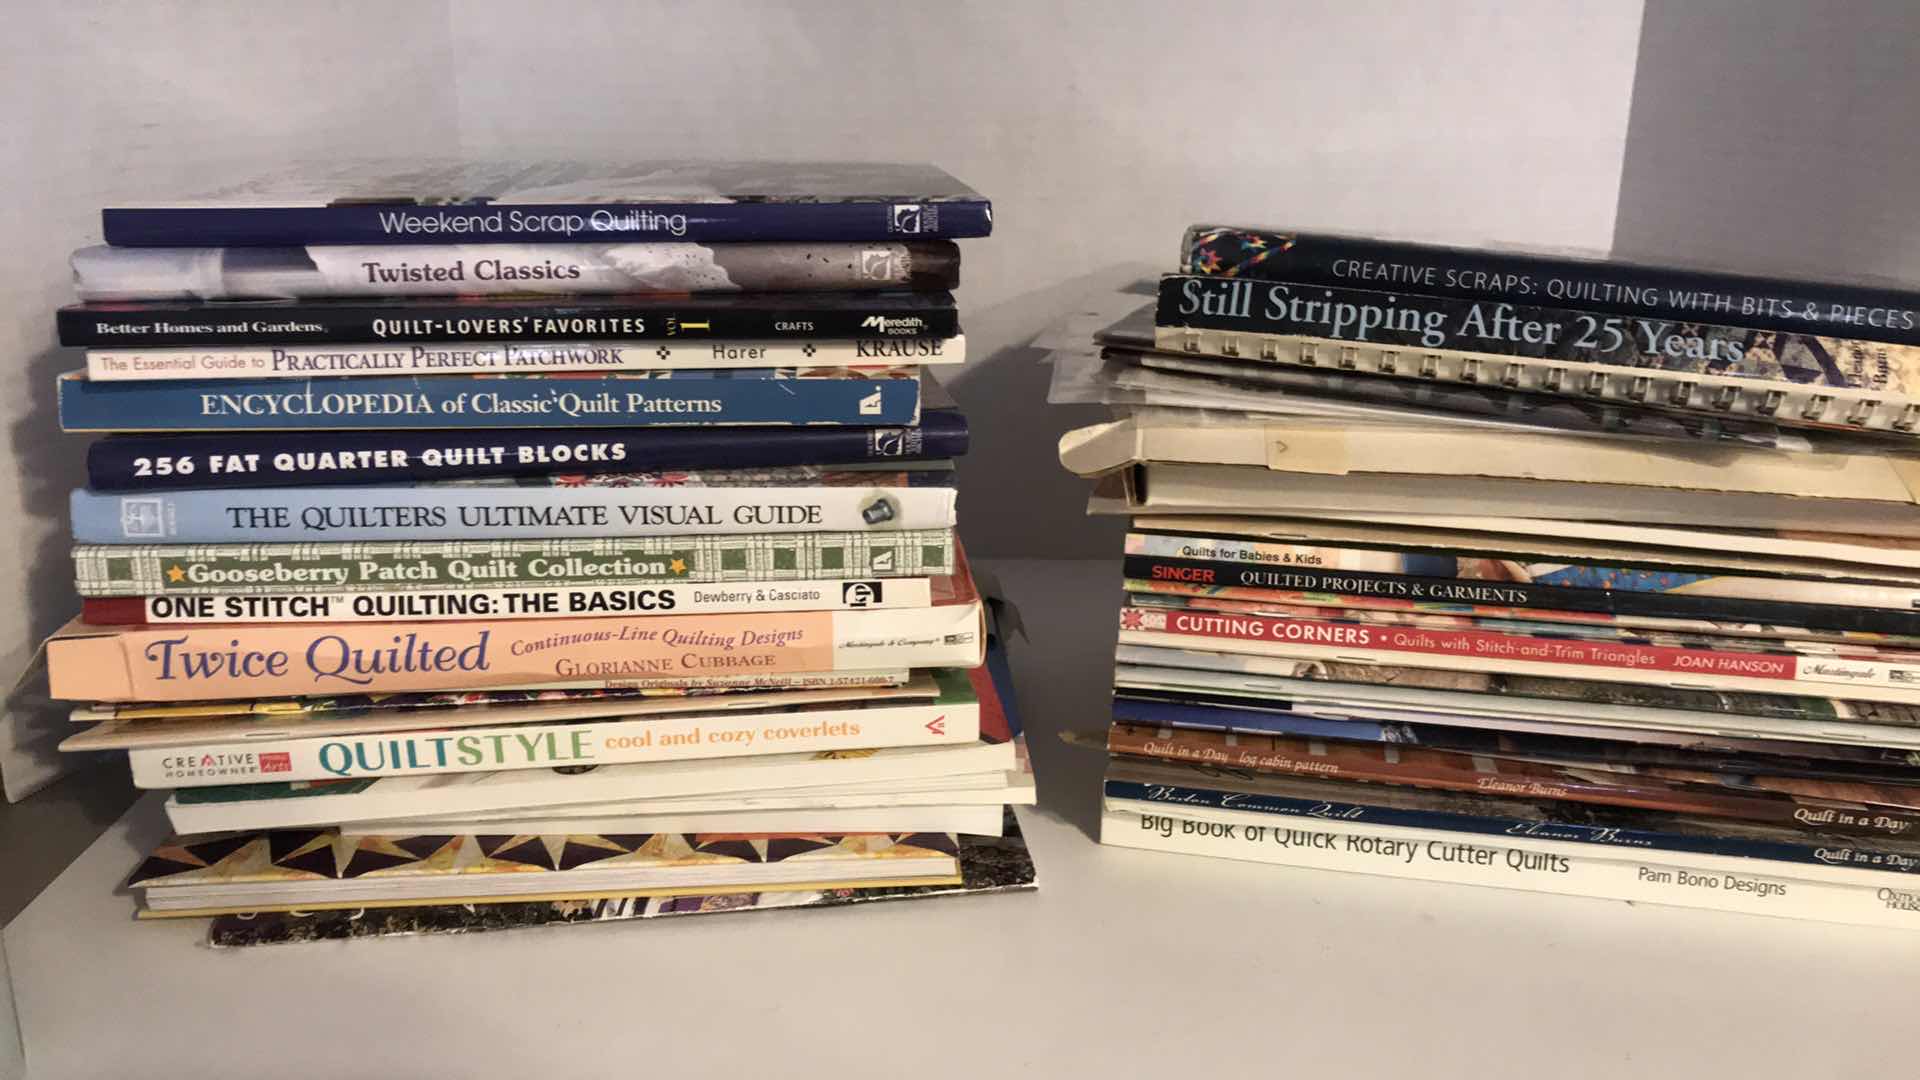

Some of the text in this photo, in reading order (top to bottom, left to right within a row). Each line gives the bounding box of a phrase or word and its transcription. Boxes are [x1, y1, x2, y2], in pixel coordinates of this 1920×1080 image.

[379, 209, 688, 237] Weekend Scrap Quilting
[362, 259, 580, 283] Twisted Classics
[1332, 258, 1914, 330] CREATIVE SCRAPS: QUILTING WITH BITS & PIECES
[96, 321, 150, 335] Better
[154, 321, 212, 334] Homes
[218, 320, 250, 334] and
[373, 315, 645, 337] QUILT-LOVERS' FAVORITES
[774, 320, 815, 332] CRAFTS
[861, 315, 923, 332] Meredith
[887, 327, 918, 335] BOOKS
[1179, 280, 1746, 362] Still Stripping After 25 Years
[711, 345, 769, 360] Harer
[856, 340, 943, 358] KRAUSE
[101, 354, 265, 371] The Essential Guide to
[200, 392, 722, 417] ENCYCLOPEDIA of Classic Quilt Patterns
[134, 443, 627, 477] 256 FAT QUARTER QUILT BLOCKS
[225, 503, 823, 531] THE QUILTERS ULTIMATE VISUAL GUIDE
[1181, 545, 1323, 565] Quilts for Babies & Kids
[187, 555, 667, 587] Gooseberry Patch Quilt Collection
[1151, 564, 1216, 583] SINGER
[693, 587, 821, 606] Dewberry & Casciato
[1240, 571, 1528, 604] QUILTED PROJECTS & GARMENTS
[150, 596, 215, 619] ONE
[352, 591, 499, 616] QUILTING:
[508, 592, 560, 614] THE
[568, 589, 677, 613] BASICS
[510, 626, 804, 657] Continuous-Line Quilting Designs
[1176, 615, 1265, 636] CUTTING
[1272, 621, 1371, 645] CORNERS
[144, 631, 491, 684] Twice Quilted
[1393, 632, 1656, 666] Quilts with Stitch-and-Trim Triangles
[555, 653, 777, 678] GLORIANNE CUBBAGE
[1671, 654, 1784, 675] JOAN HANSON
[705, 678, 751, 687] Suzanne
[161, 753, 254, 769] CREATIVE
[319, 721, 861, 777] QUILTSTYLE cool and cozy coverlets
[1143, 742, 1340, 774] Quilt in a Day log cabin pattern
[1477, 777, 1569, 798] Eleanor Burns
[1146, 783, 1368, 819] Boston Common Quilt
[1794, 808, 1908, 834] Quilt in a Day
[1140, 814, 1571, 874] Big Book of Quick Rotary Cutter Quilts
[1505, 822, 1653, 847] Eleanor Burns
[1813, 848, 1919, 871] Quilt in a Day
[1637, 866, 1788, 897] Pam Bono Designs
